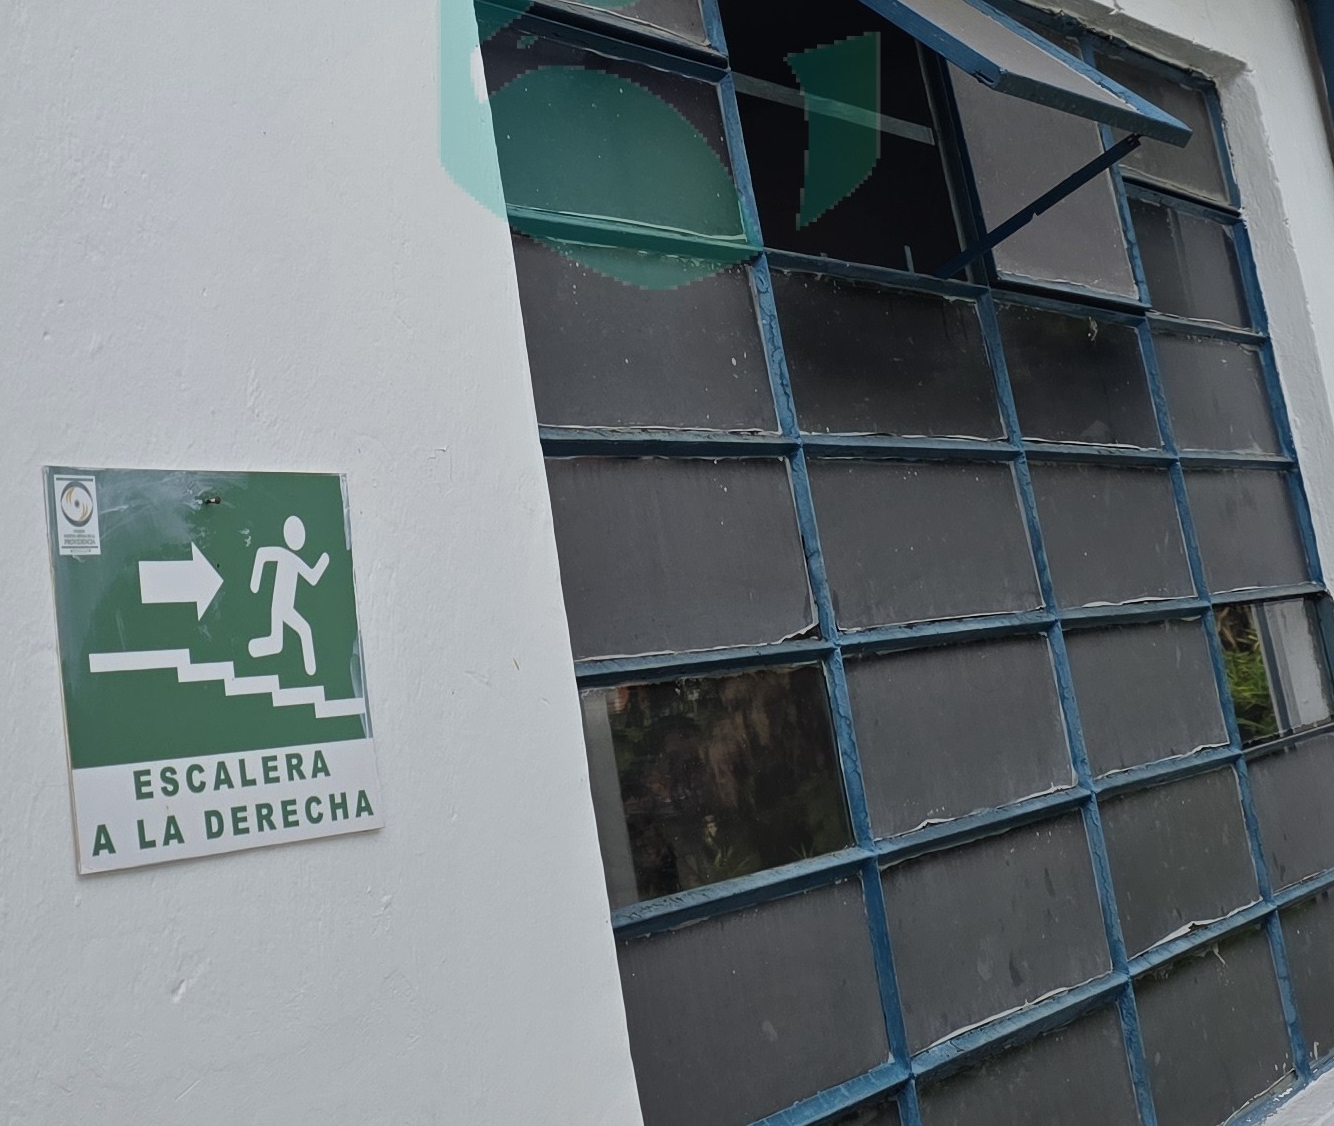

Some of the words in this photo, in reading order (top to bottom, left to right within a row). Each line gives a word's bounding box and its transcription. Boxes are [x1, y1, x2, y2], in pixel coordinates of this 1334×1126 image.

[133, 749, 331, 801] ESCALERA
[92, 824, 116, 857] A
[136, 815, 185, 849] LA
[204, 789, 374, 840] DERECHA
